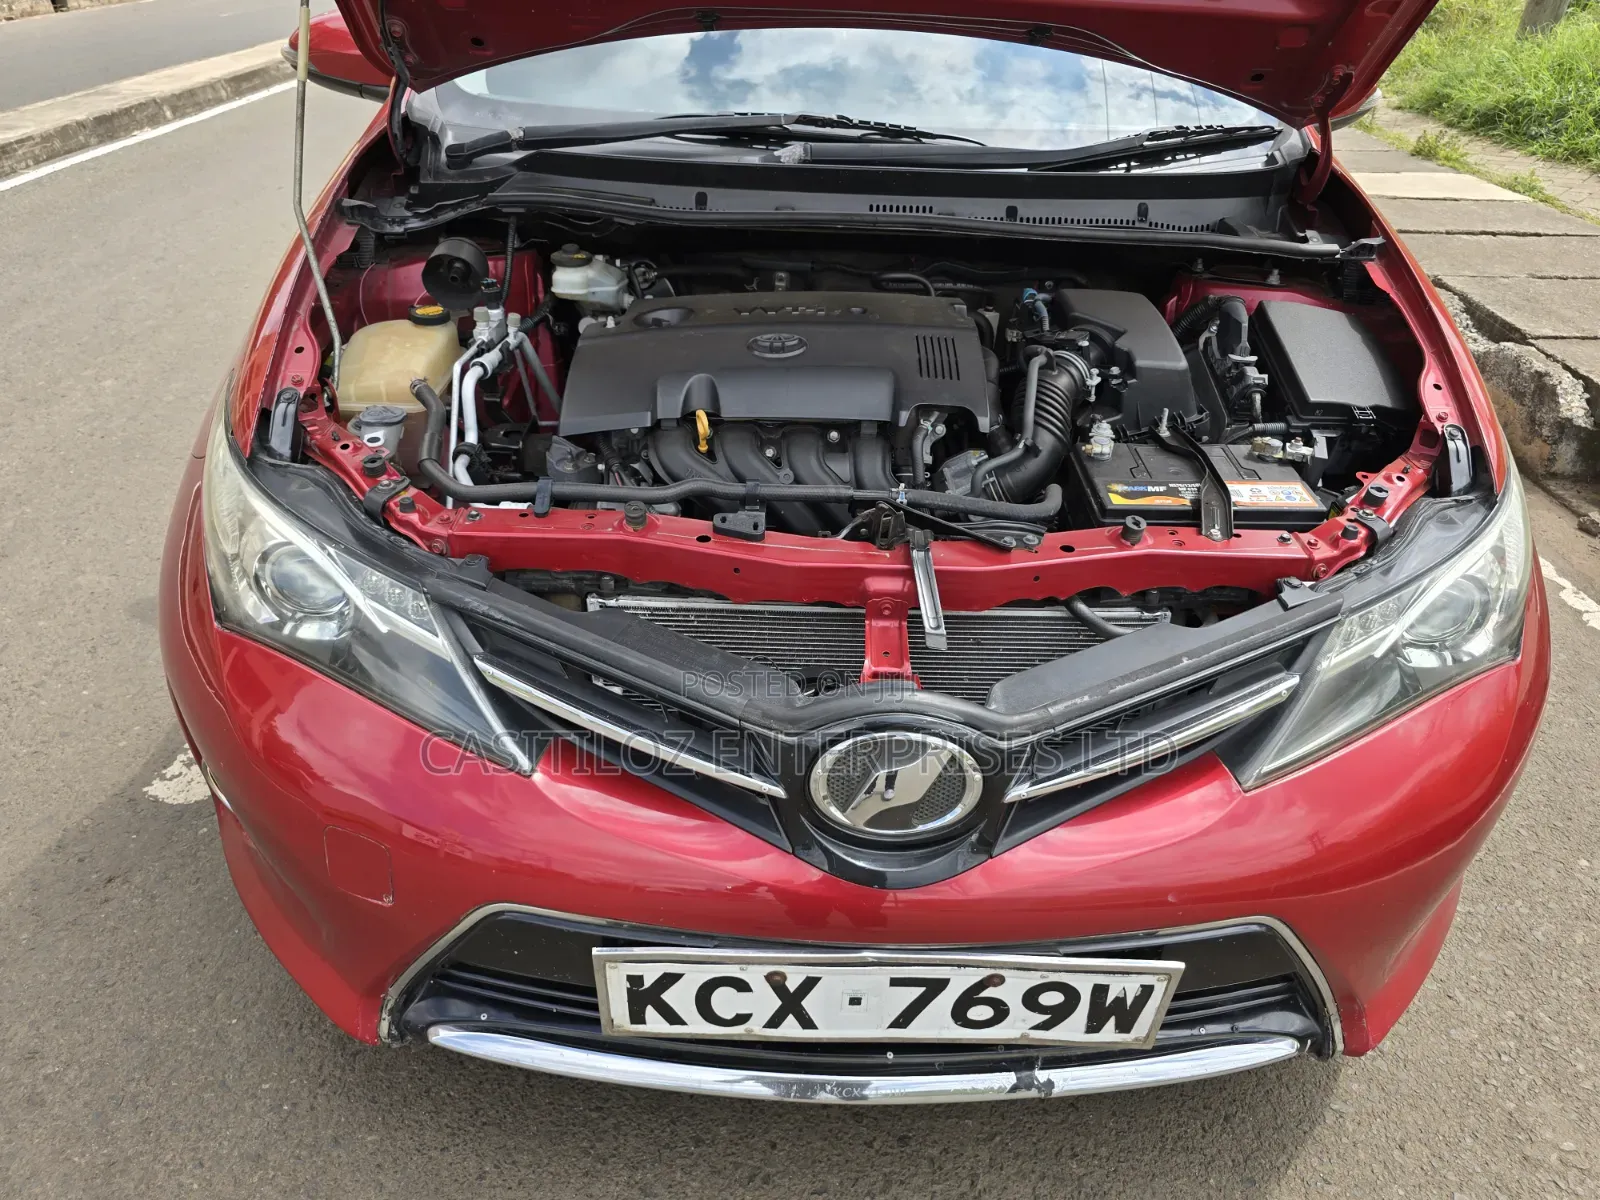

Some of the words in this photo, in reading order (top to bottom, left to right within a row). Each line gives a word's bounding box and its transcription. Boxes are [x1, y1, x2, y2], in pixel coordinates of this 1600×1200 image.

[626, 971, 823, 1030] KCX
[886, 974, 1155, 1034] 769W
[833, 1087, 861, 1098] KCX
